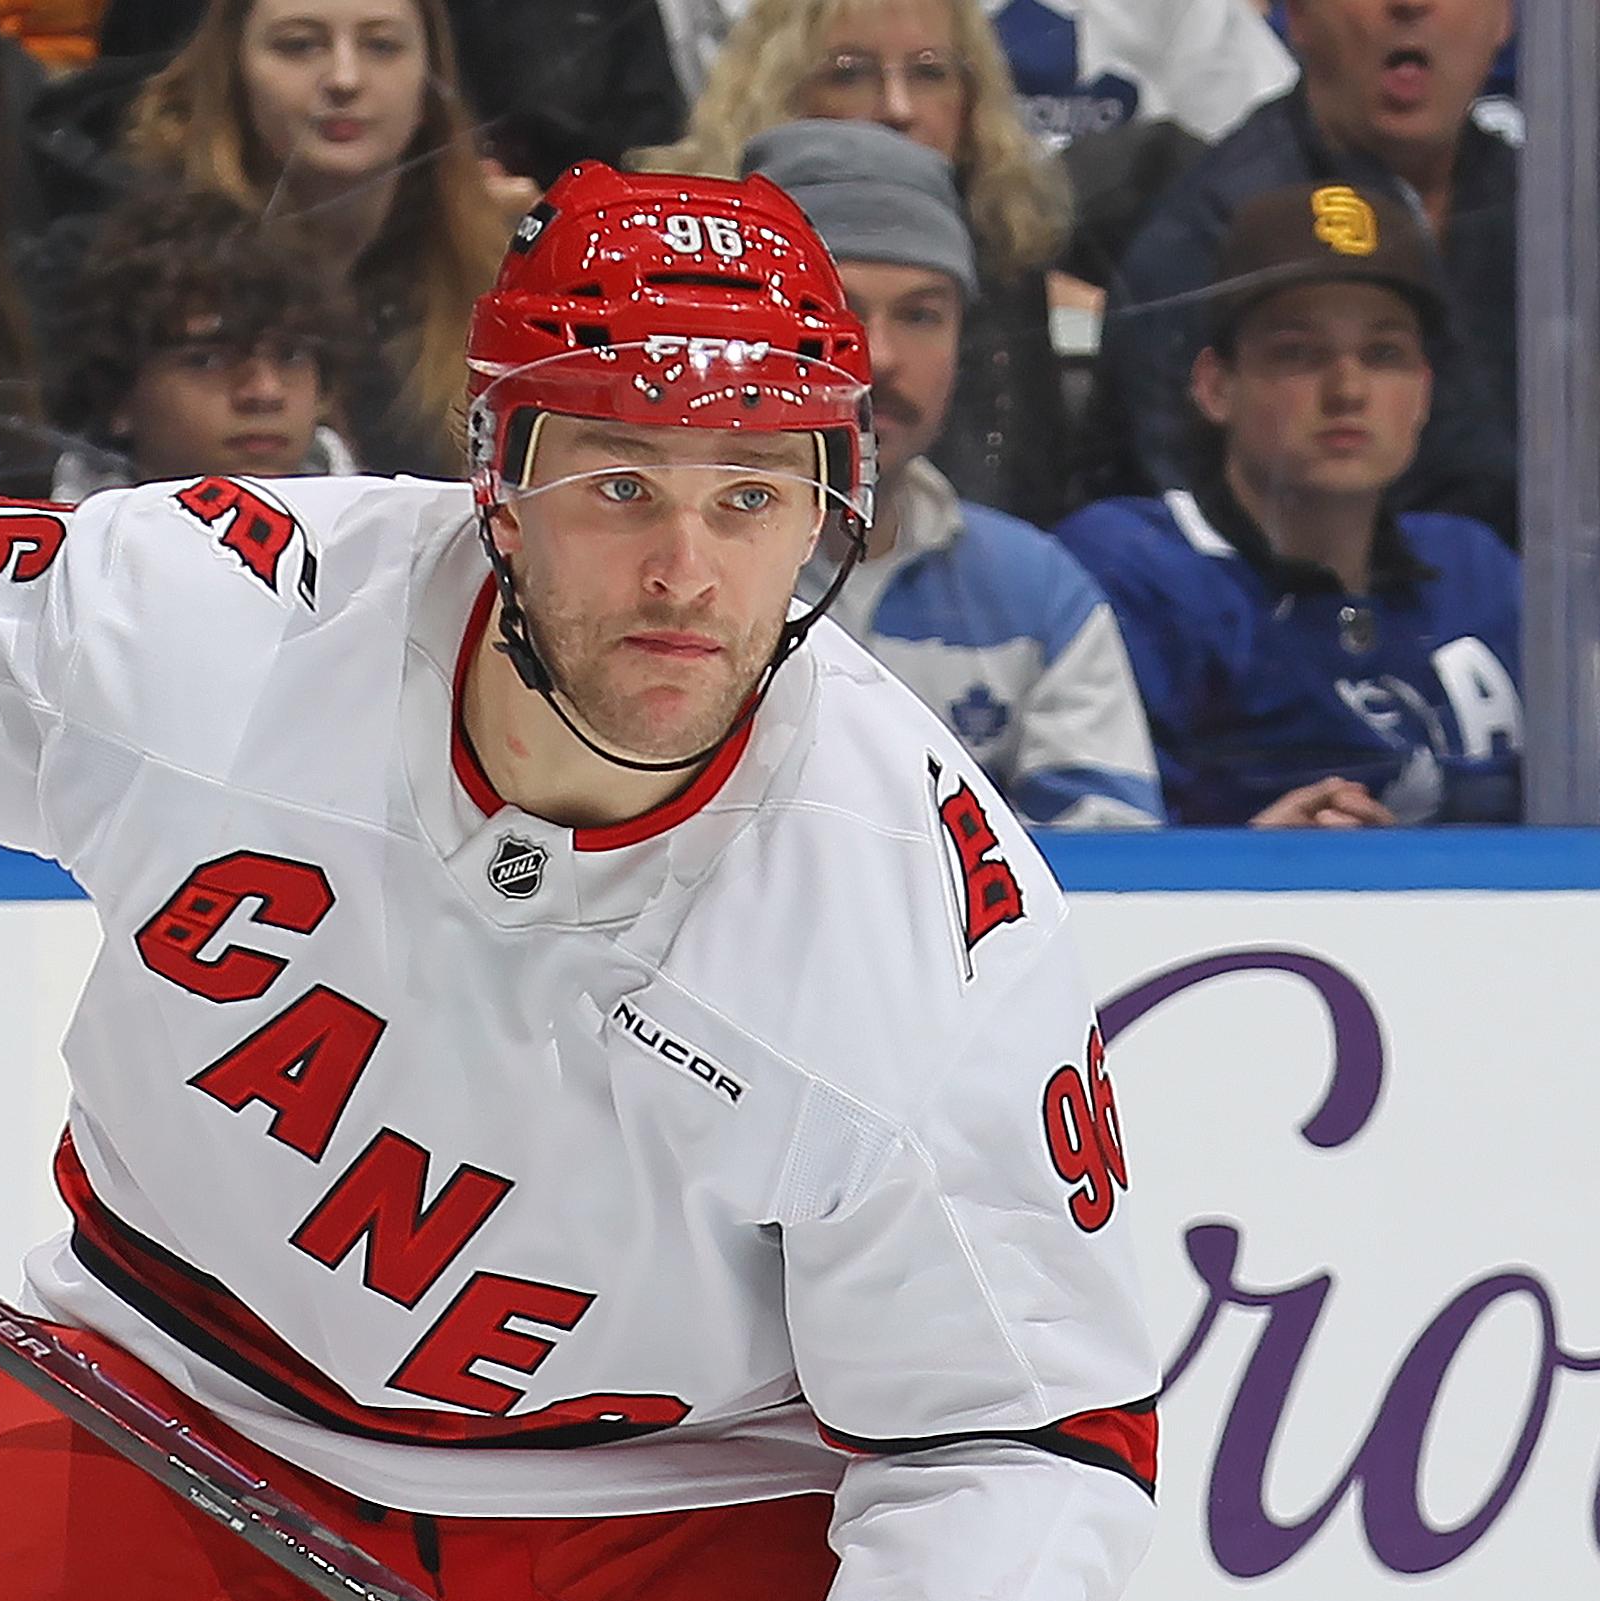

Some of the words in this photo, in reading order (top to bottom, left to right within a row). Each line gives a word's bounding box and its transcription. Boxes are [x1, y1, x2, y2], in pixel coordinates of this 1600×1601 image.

[666, 214, 744, 258] 96
[1432, 635, 1525, 760] A
[498, 856, 536, 881] NHL
[612, 1002, 743, 1103] NUCOR
